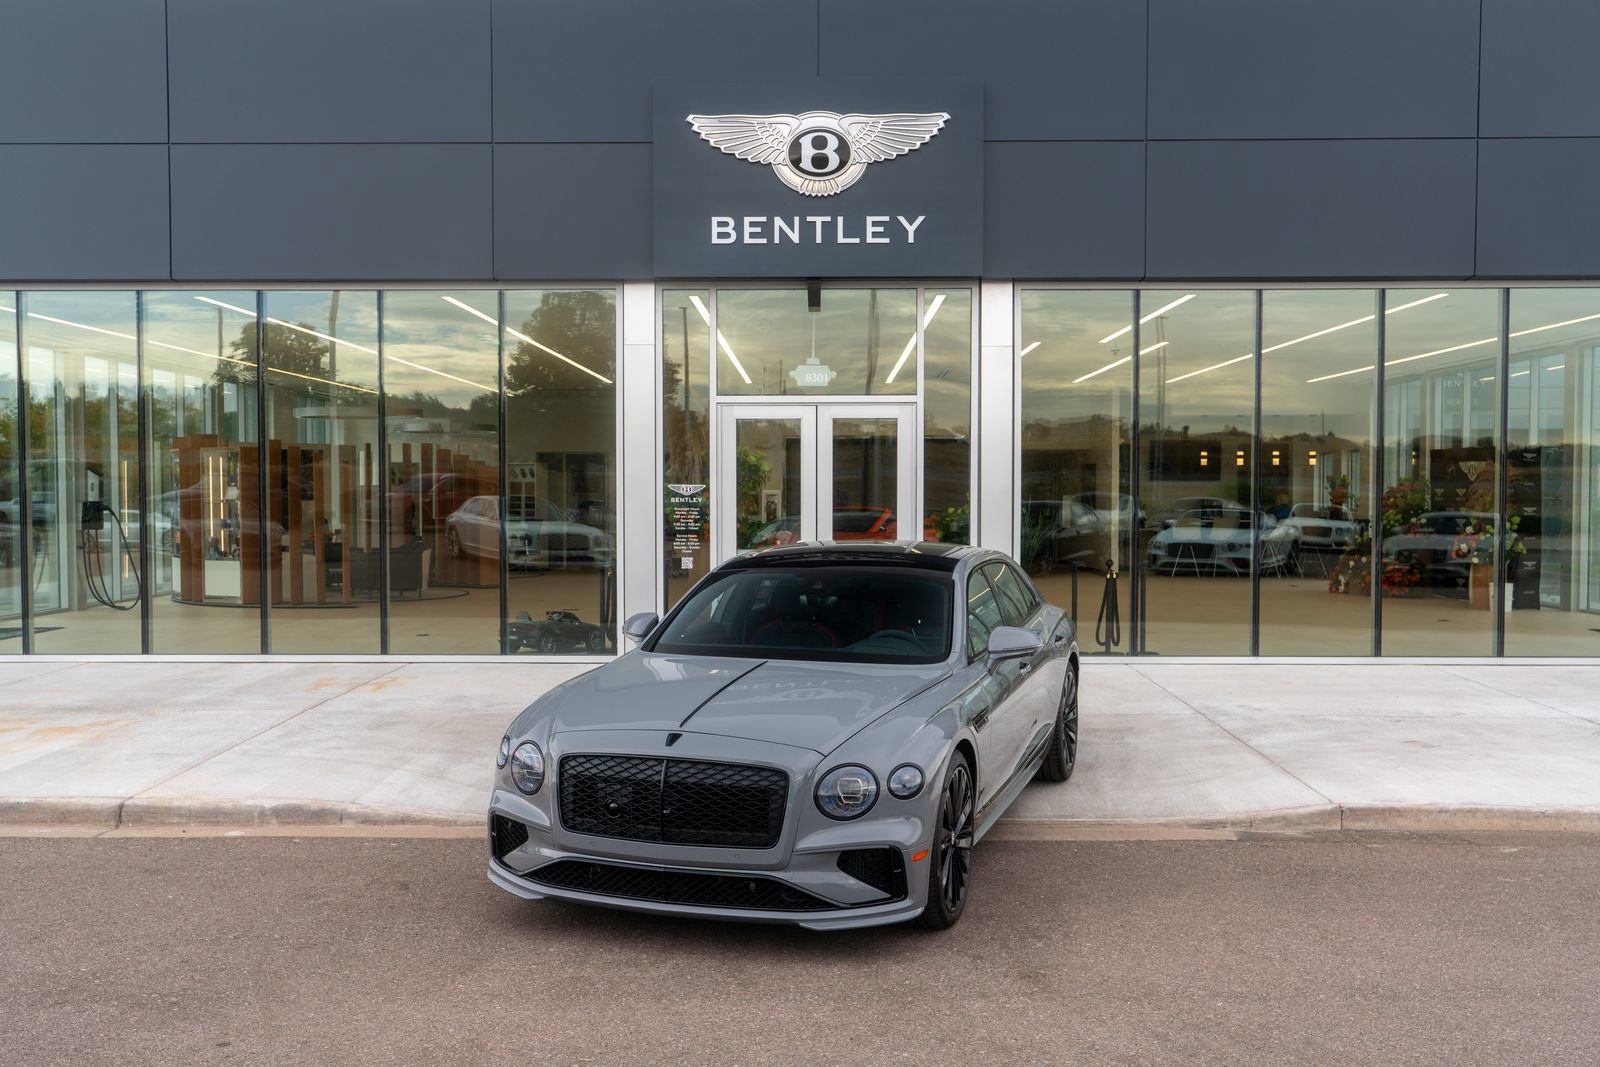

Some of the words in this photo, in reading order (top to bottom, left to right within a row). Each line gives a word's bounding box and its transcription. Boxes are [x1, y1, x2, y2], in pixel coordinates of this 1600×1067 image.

[799, 132, 840, 173] B
[711, 215, 927, 244] BENTLEY
[807, 373, 828, 383] 8301
